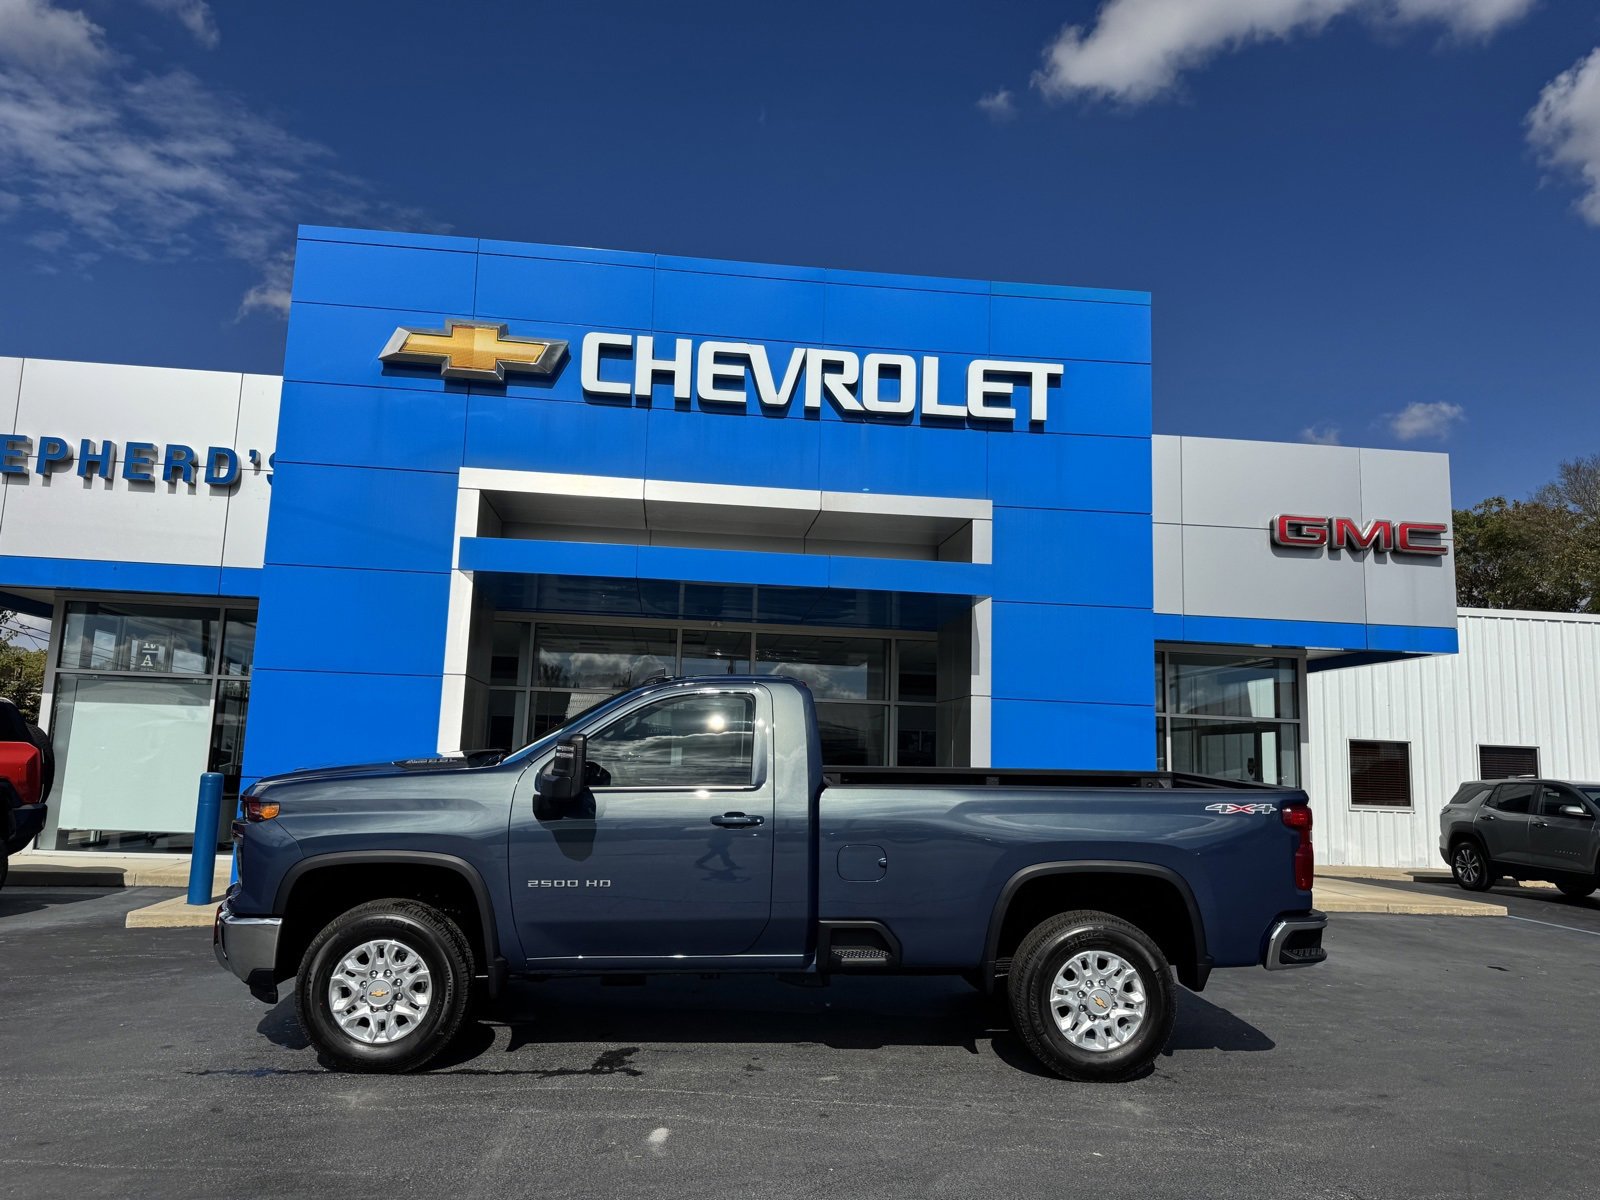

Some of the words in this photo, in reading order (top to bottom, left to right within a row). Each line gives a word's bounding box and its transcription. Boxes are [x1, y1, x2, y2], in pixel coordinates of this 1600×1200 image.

[581, 331, 1064, 421] CHEVROLET
[0, 434, 277, 486] EPHERD'
[1273, 514, 1449, 556] GMC
[528, 879, 578, 888] 2500
[586, 879, 611, 888] HD
